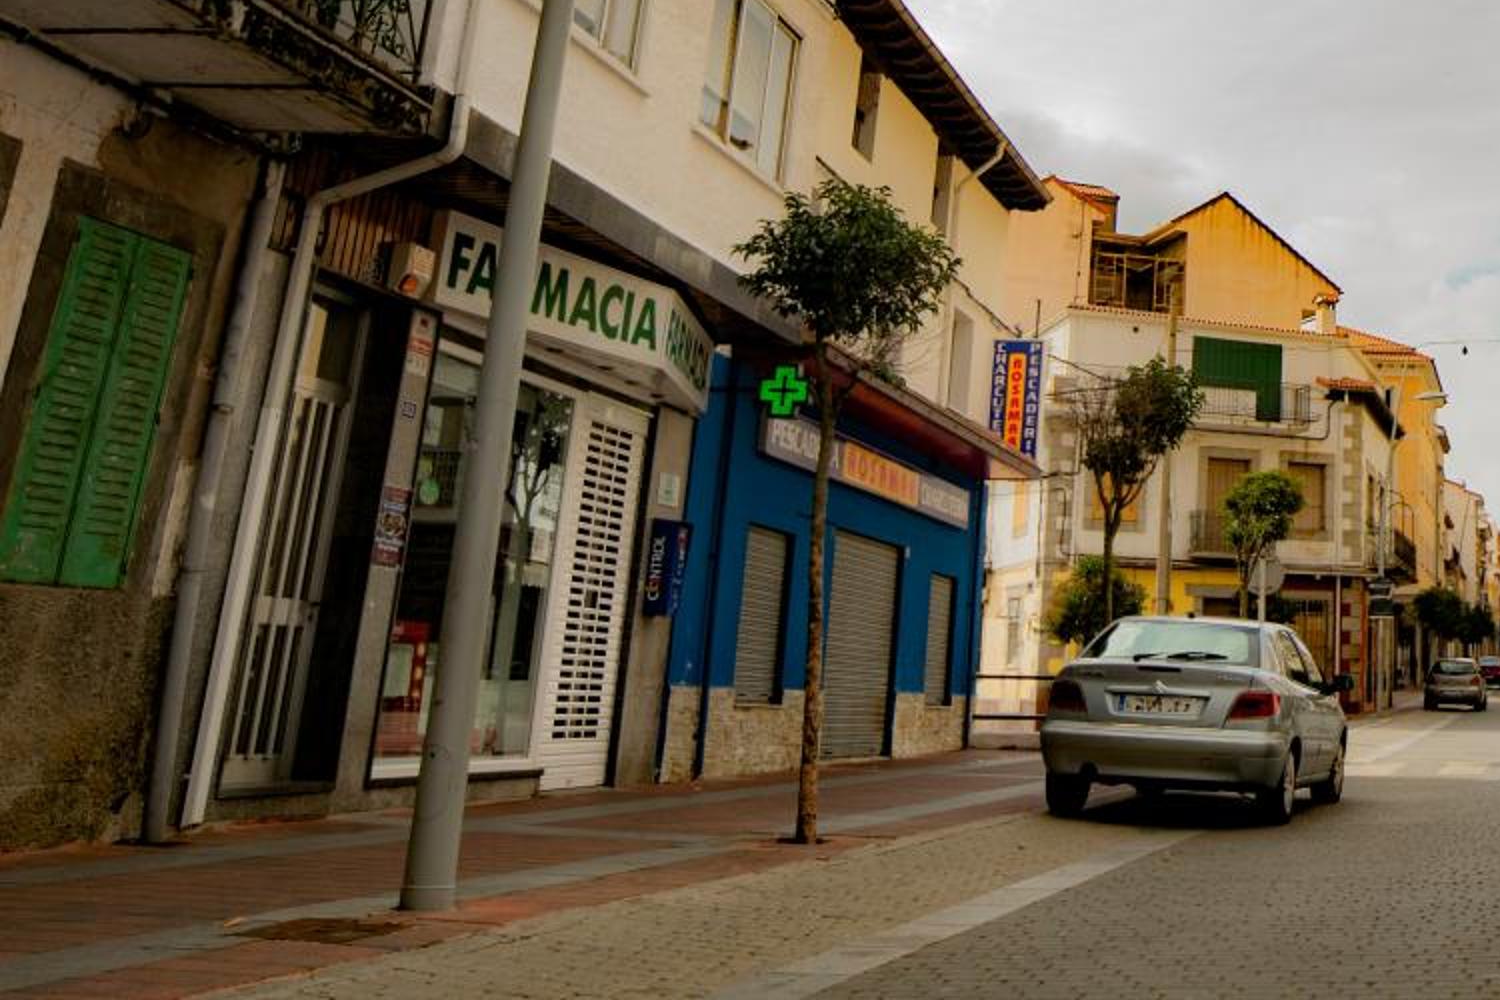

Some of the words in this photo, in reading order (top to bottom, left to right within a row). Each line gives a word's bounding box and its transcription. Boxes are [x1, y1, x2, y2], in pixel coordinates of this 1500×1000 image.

[447, 231, 657, 351] FAMACIA
[1023, 342, 1041, 458] PESCADERI
[646, 535, 667, 601] CONTROL
